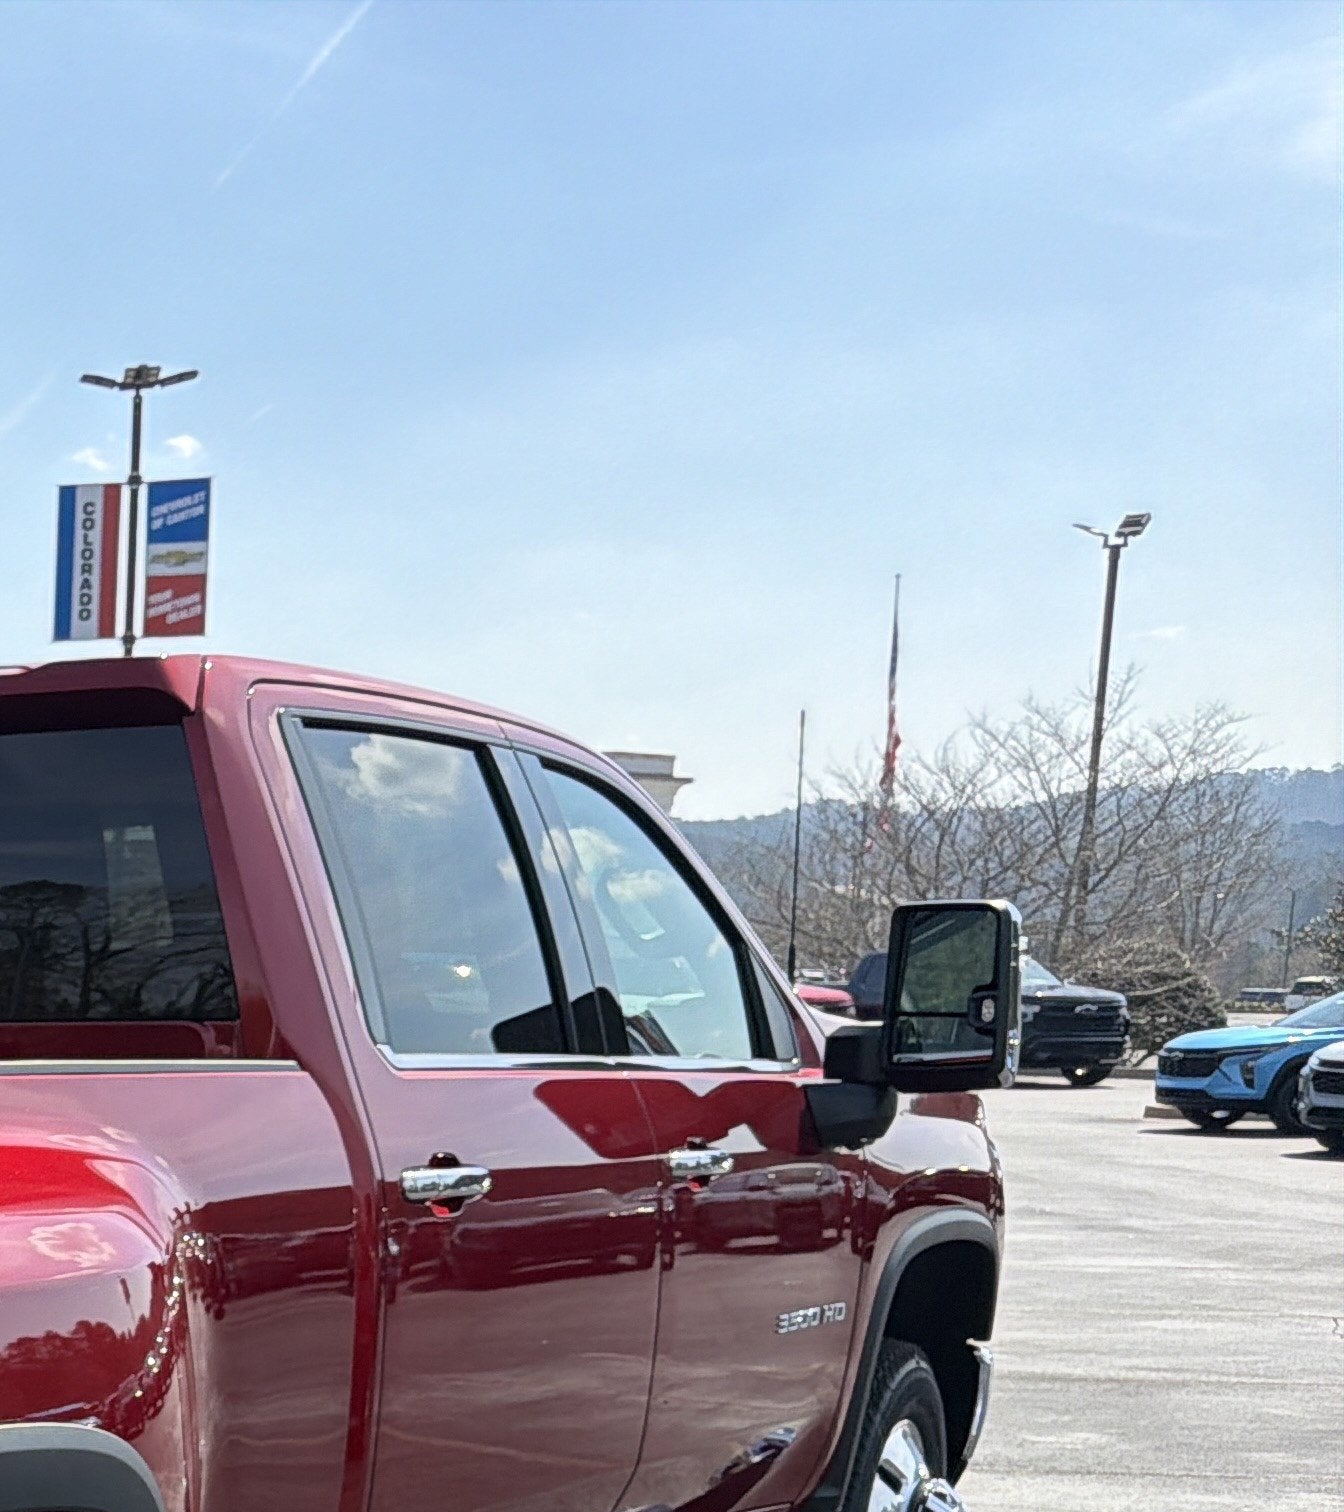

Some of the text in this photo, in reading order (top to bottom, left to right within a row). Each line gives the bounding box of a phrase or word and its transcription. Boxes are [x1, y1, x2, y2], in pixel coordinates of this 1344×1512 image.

[78, 501, 96, 622] COLORADO
[777, 1302, 846, 1334] 3500 HD
